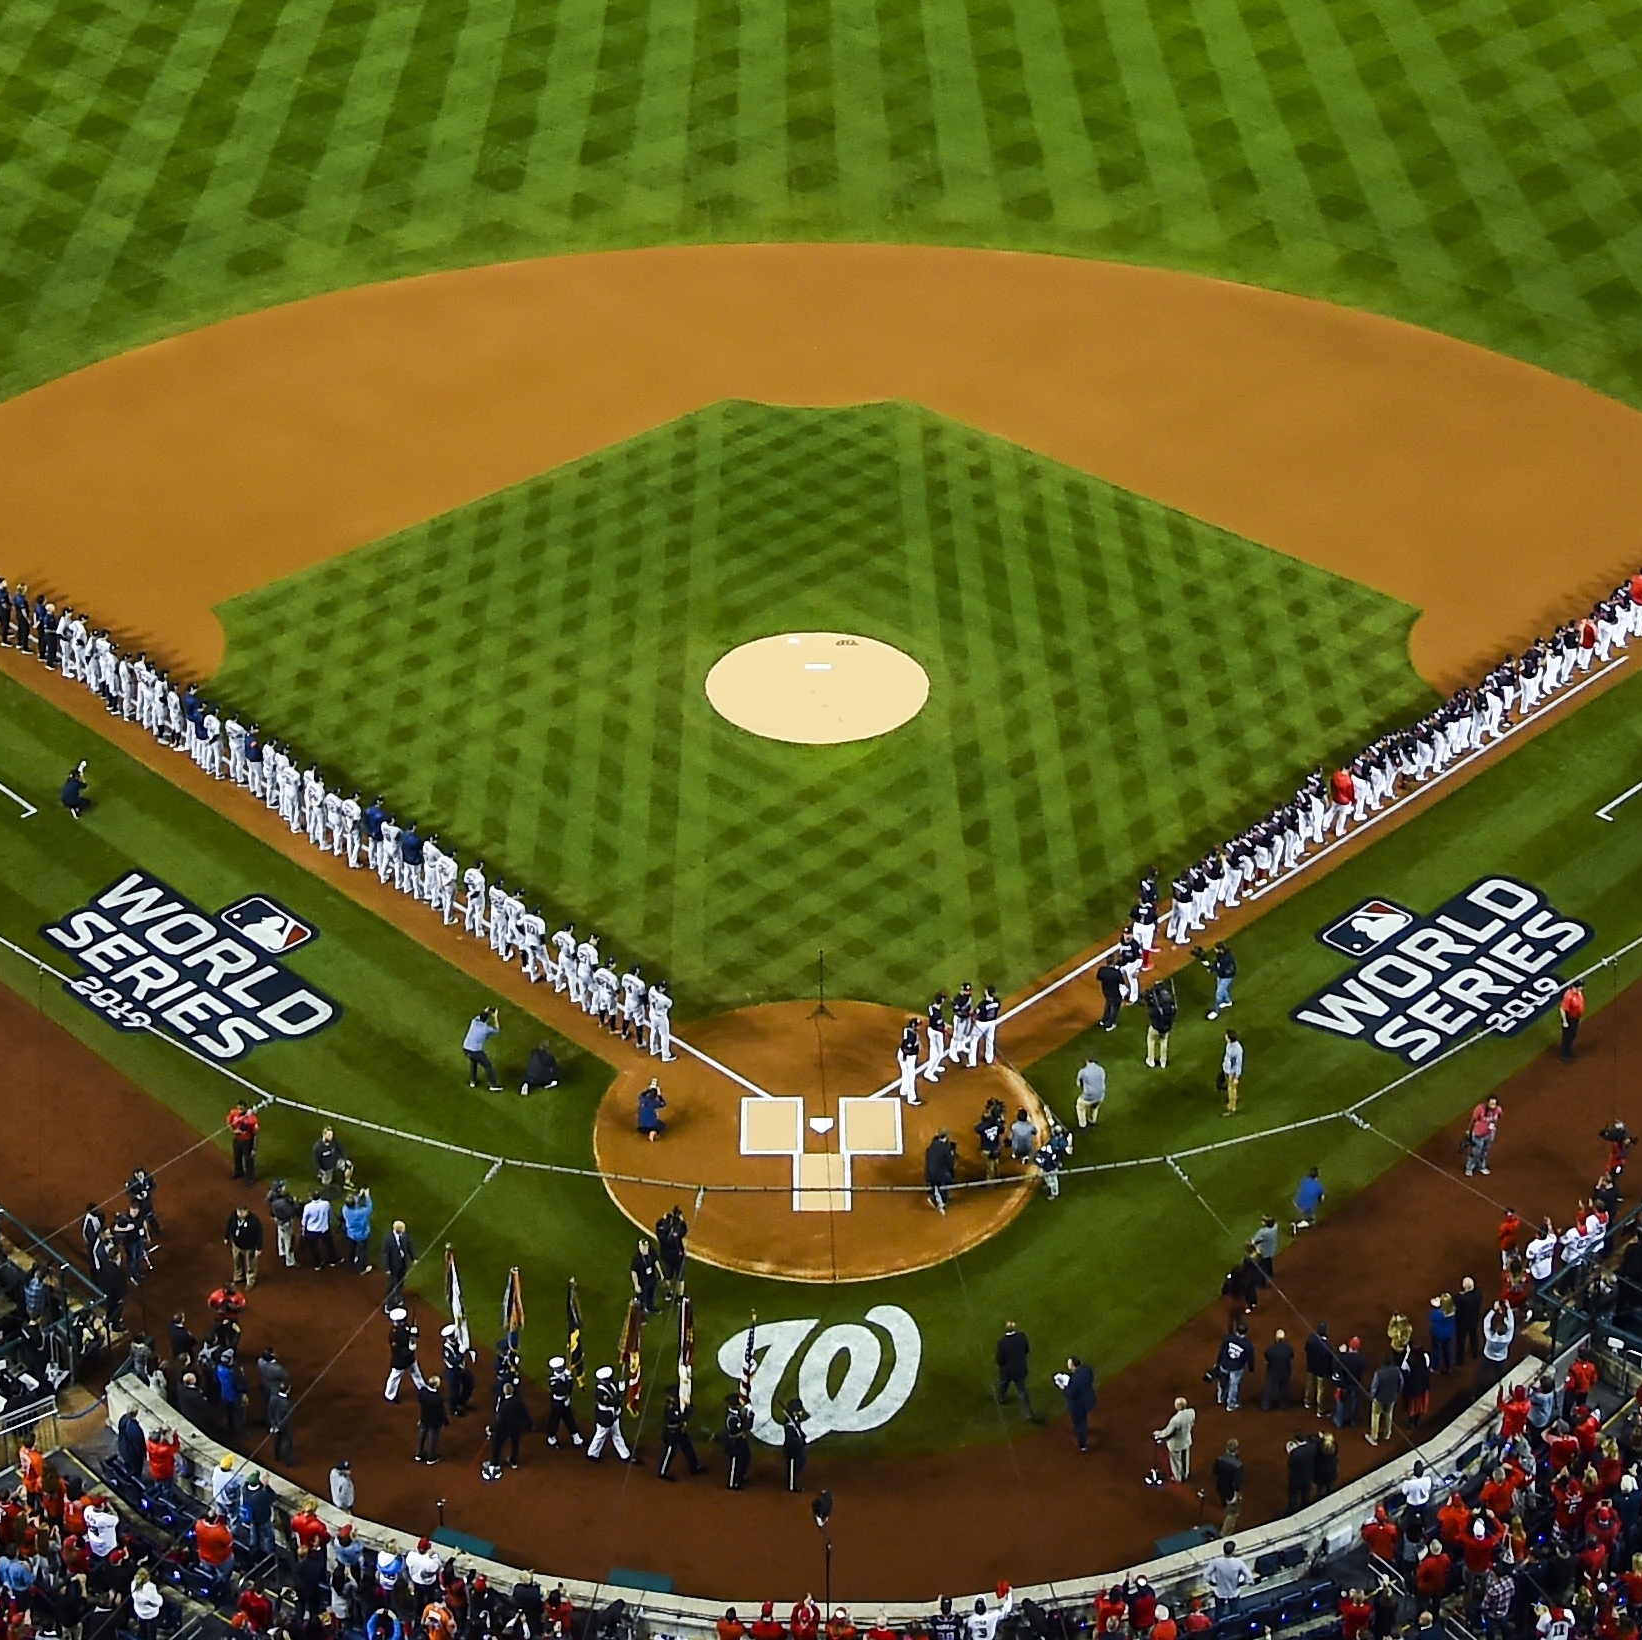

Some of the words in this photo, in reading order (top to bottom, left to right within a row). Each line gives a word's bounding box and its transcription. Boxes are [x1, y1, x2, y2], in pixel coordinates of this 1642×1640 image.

[46, 911, 271, 1058] SERIES
[70, 976, 152, 1028] 2019
[97, 873, 333, 1035] WORLD
[1296, 879, 1538, 1035] WORLD
[1374, 910, 1586, 1061] SERIES
[1485, 977, 1560, 1033] 2019
